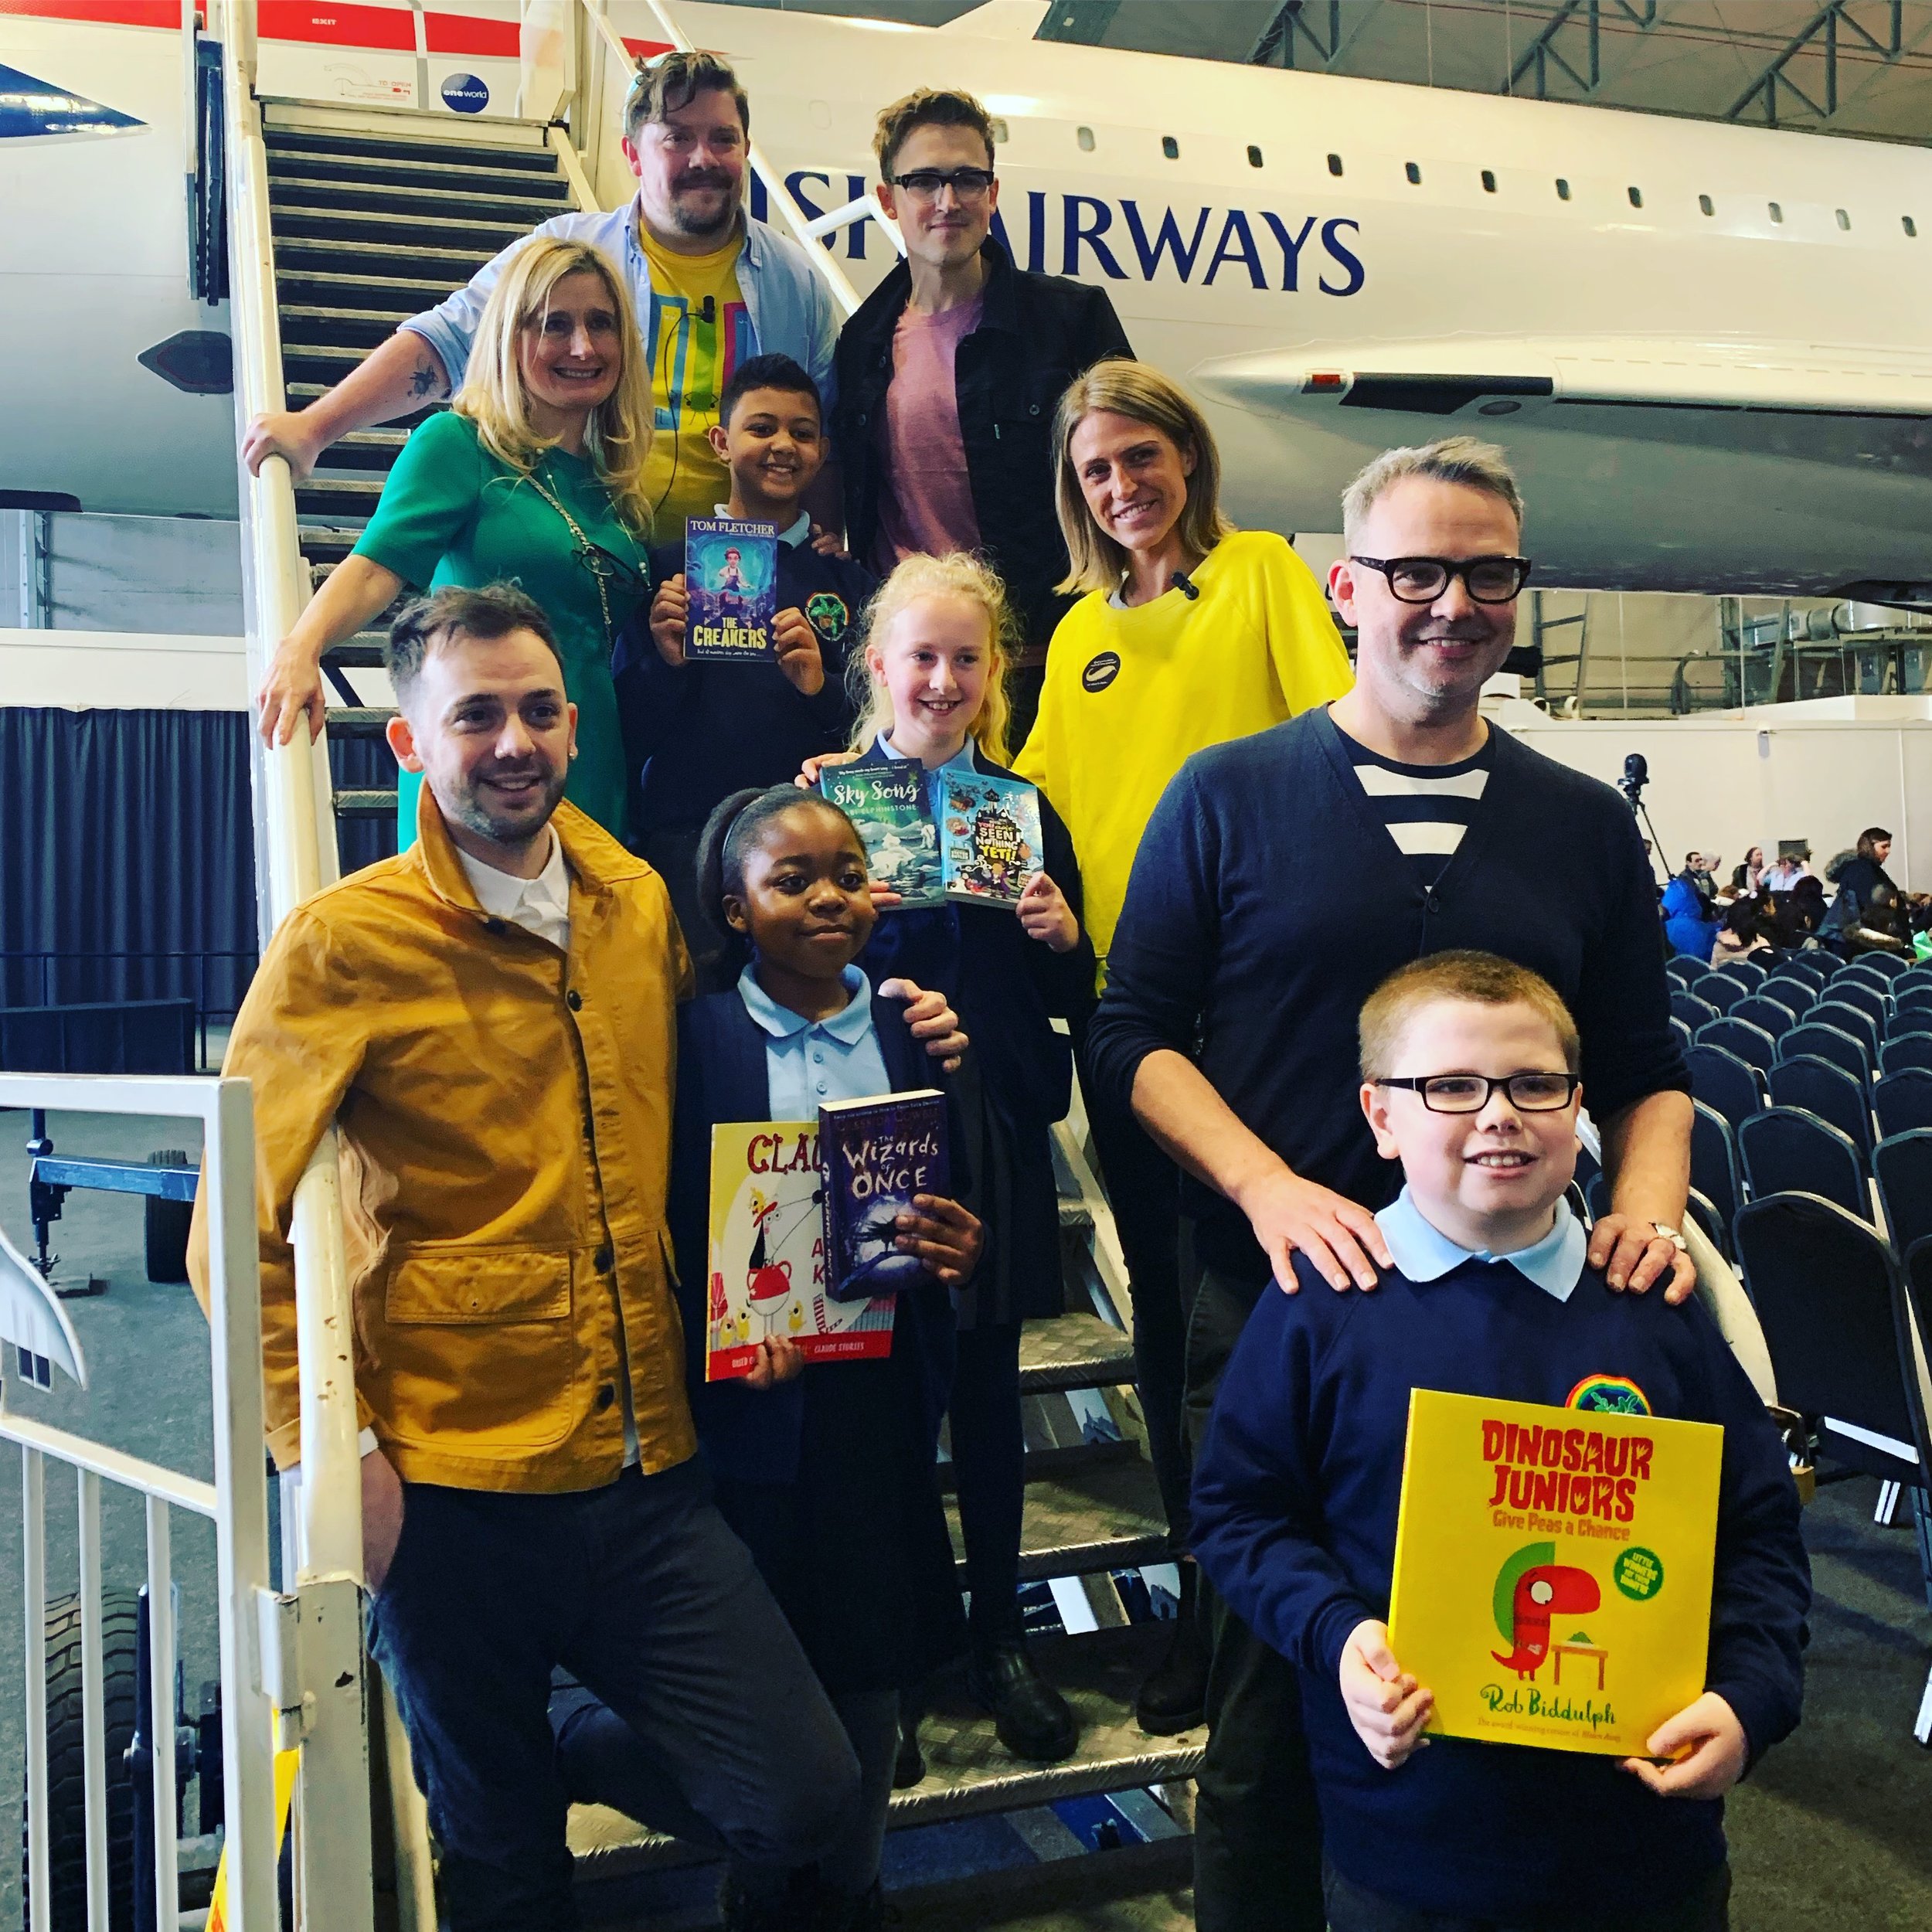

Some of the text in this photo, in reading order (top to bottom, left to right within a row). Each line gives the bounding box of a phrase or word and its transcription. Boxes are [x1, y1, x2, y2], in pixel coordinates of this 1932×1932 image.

[690, 520, 775, 535] TOM FLETCHER
[693, 624, 767, 649] CREAKERS
[722, 617, 738, 628] THE
[834, 780, 920, 808] Sky Song
[975, 835, 1018, 851] NOTHING
[979, 827, 1013, 842] SEEN
[842, 1132, 938, 1168] Wizards
[852, 1166, 927, 1199] ONCE
[881, 1164, 890, 1175] of
[1481, 1419, 1654, 1481] DINOSAUR
[1488, 1464, 1637, 1522] JUNIORS
[1492, 1509, 1631, 1541] Give Peas a Chance
[1480, 1683, 1617, 1733] Rob Biddulph
